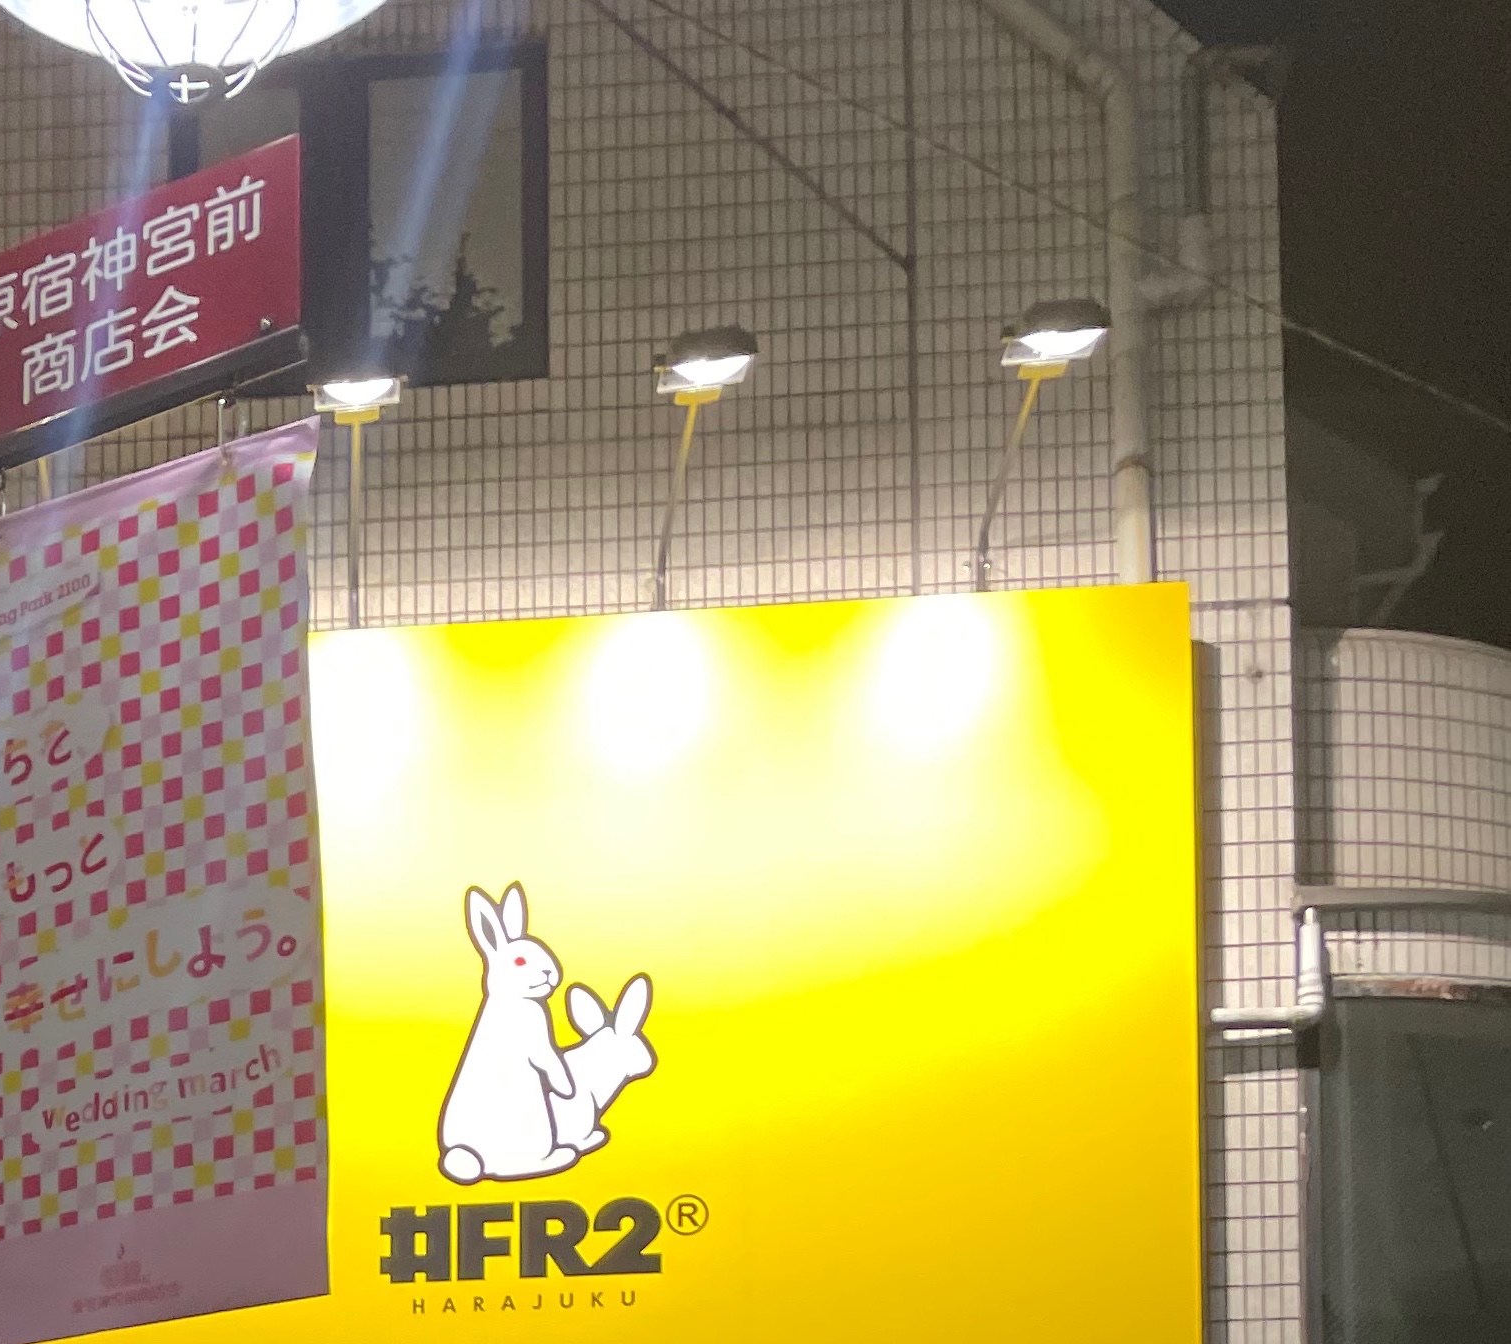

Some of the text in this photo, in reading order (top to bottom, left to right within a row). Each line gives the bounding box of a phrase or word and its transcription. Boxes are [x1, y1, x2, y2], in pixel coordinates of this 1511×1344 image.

[21, 285, 201, 405] 商店会
[19, 591, 54, 617] Park
[3, 907, 297, 1035] 幸せにしよう。
[177, 1044, 283, 1100] march
[412, 1290, 637, 1315] HARAJUKU
